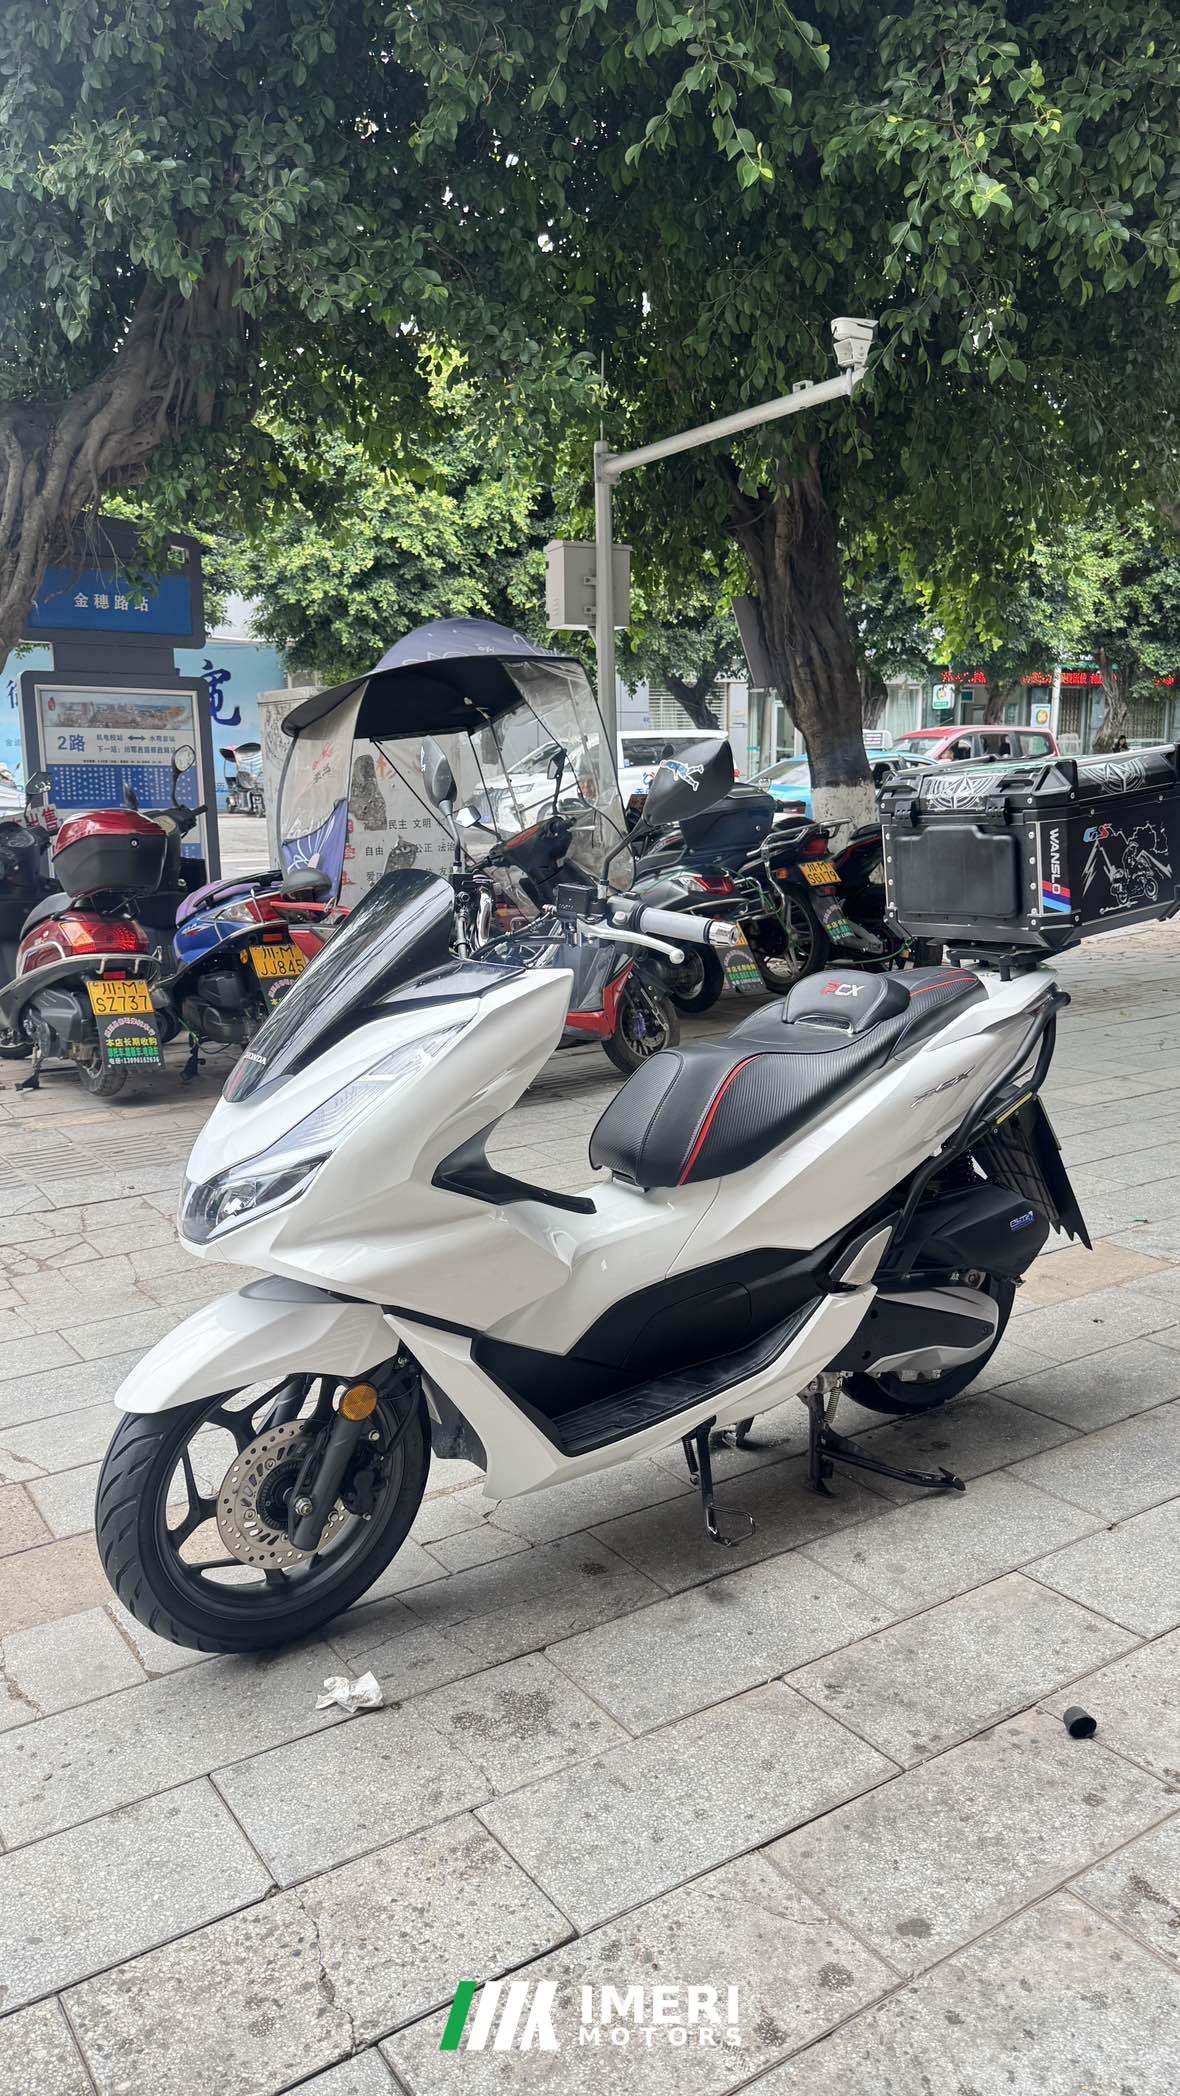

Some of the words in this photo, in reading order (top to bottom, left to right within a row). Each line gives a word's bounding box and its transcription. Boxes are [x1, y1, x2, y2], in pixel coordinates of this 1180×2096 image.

[57, 735, 85, 753] 2路
[388, 819, 408, 830] 民主
[413, 818, 431, 829] 文明
[365, 846, 384, 856] 自由
[1049, 828, 1061, 894] WANSLO
[261, 959, 305, 975] JJ845
[96, 996, 148, 1012] SZ737
